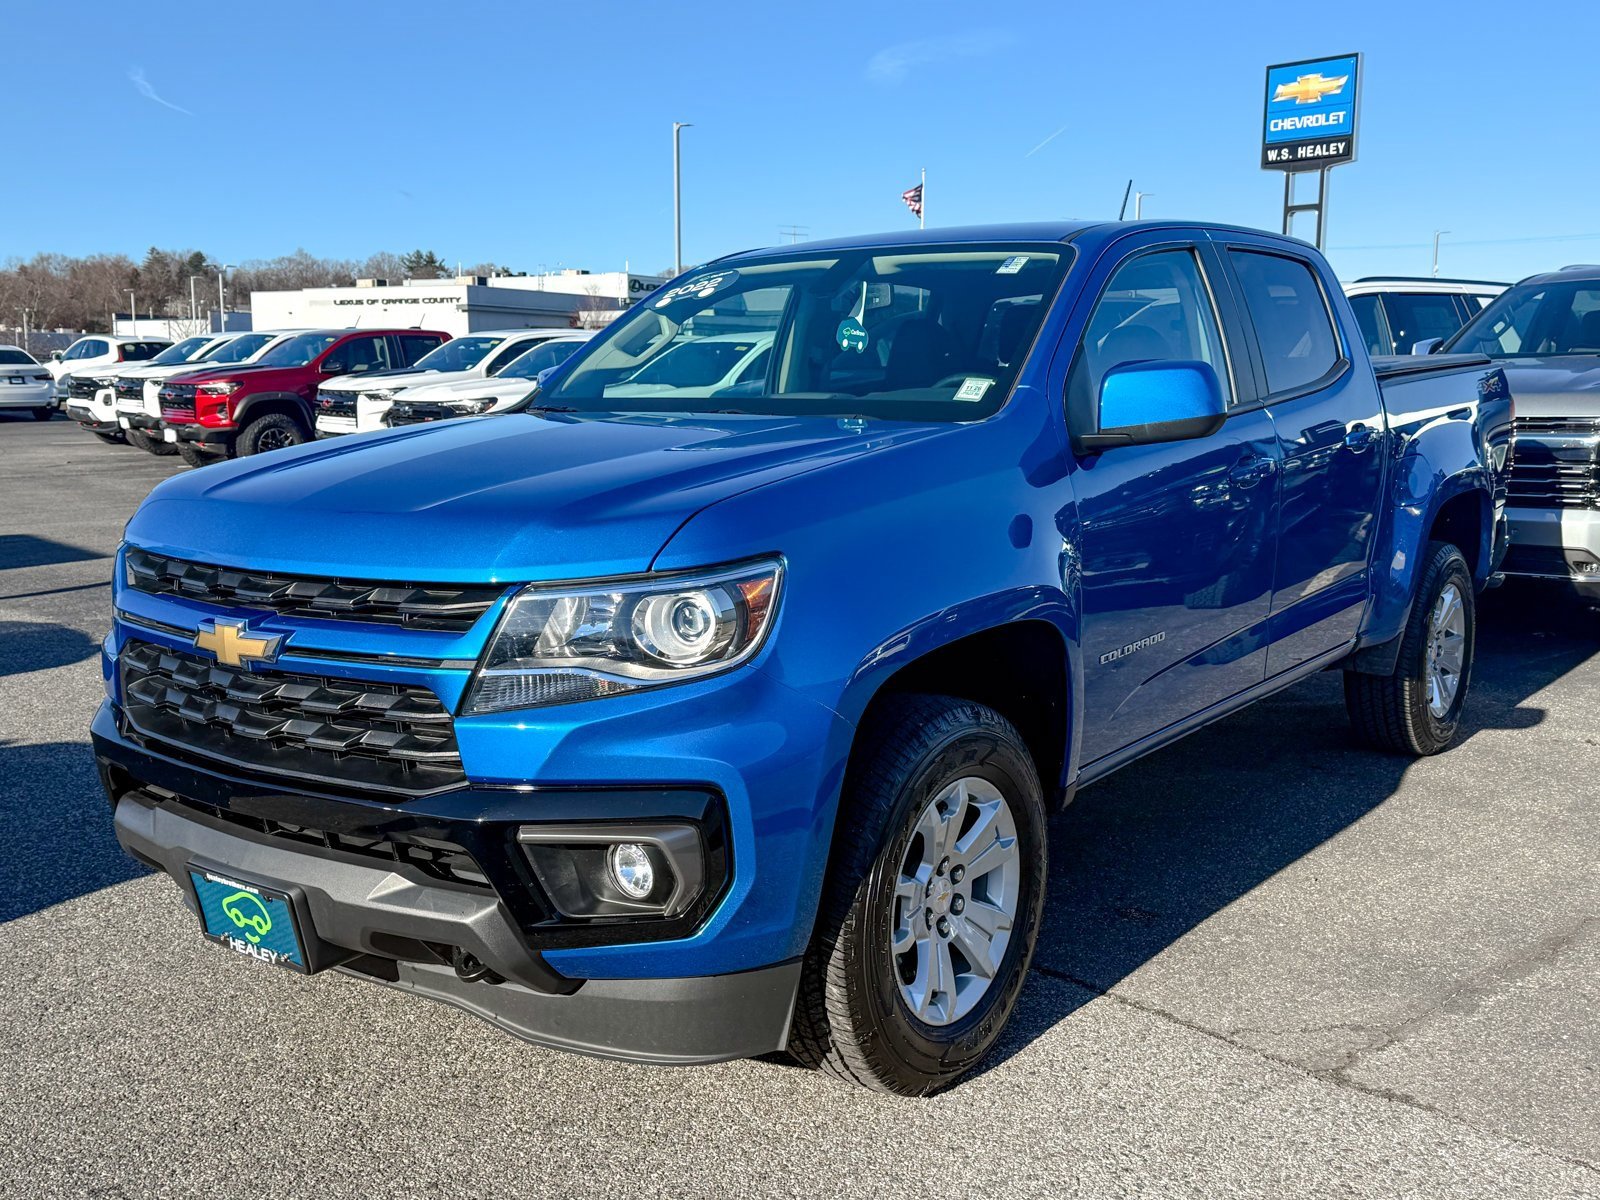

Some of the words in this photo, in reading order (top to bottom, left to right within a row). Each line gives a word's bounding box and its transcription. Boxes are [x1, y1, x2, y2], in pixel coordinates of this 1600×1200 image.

[1269, 111, 1347, 132] CHEVROLET
[1267, 148, 1293, 161] W.S.
[1297, 142, 1346, 158] HEALEY
[662, 277, 723, 299] 2022
[1099, 631, 1166, 665] COLORADO
[229, 937, 278, 964] HEALEY
